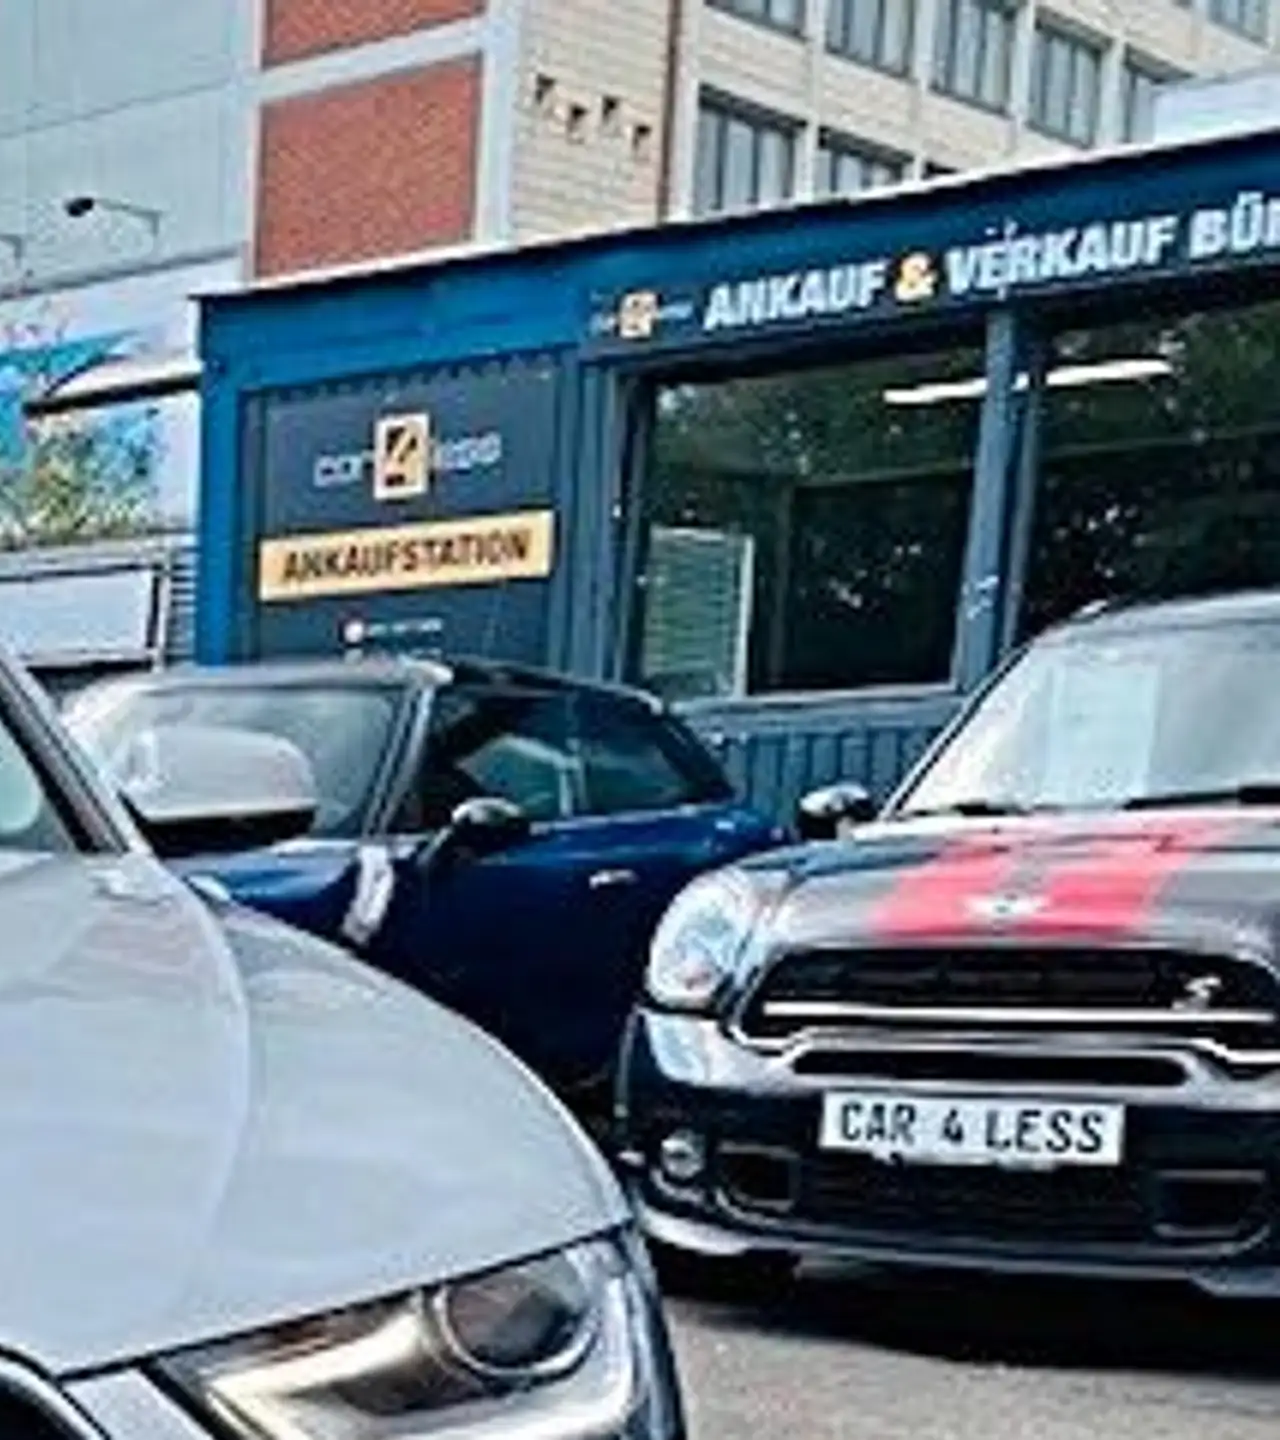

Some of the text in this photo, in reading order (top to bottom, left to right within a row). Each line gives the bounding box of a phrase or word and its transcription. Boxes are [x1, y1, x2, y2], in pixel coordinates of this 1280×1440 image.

[703, 258, 887, 331] ANKAUF
[895, 253, 934, 300] &
[945, 215, 1177, 293] VERKAUF
[282, 529, 532, 581] ANKAUFSTATION
[840, 1101, 1104, 1154] CAR 4 LESS
